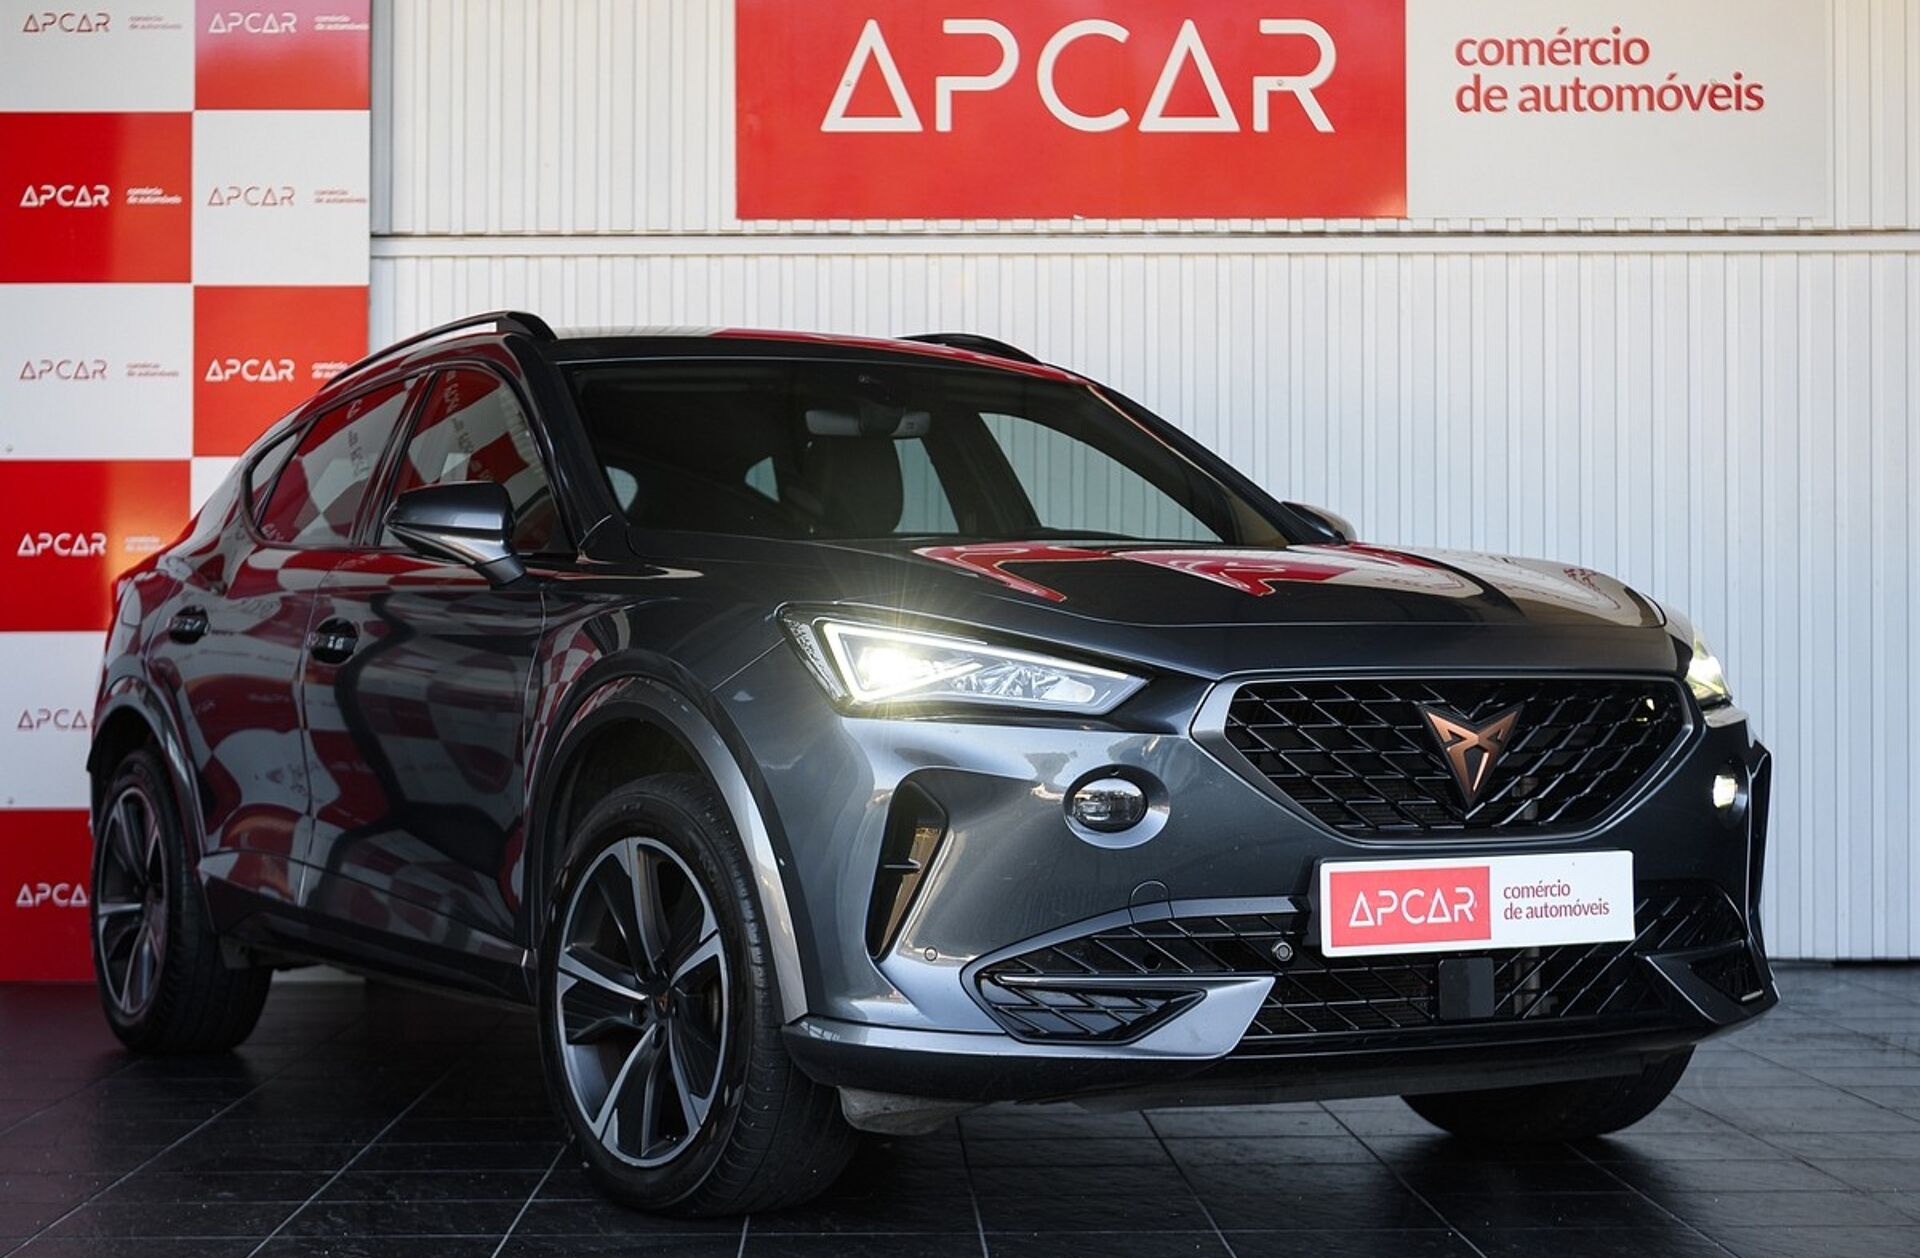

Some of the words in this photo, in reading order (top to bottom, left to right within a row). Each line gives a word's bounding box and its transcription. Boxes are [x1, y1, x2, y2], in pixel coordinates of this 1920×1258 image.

[22, 12, 111, 33] APCAR
[208, 12, 297, 34] APCAR
[1455, 25, 1650, 68] comércio
[820, 18, 1336, 133] APCAR
[1455, 74, 1507, 114] de
[1518, 73, 1764, 114] automóveis
[19, 184, 111, 208] APCAR
[207, 186, 296, 207] APCAR
[19, 359, 108, 380] APCAR
[205, 358, 296, 382] APCAR
[16, 532, 108, 557] APCAR
[17, 708, 95, 730] APCA
[15, 883, 91, 908] APCA
[1503, 879, 1571, 899] comércio
[1349, 888, 1475, 927] APCAR
[1504, 903, 1523, 920] de
[1525, 898, 1610, 919] automóveis
